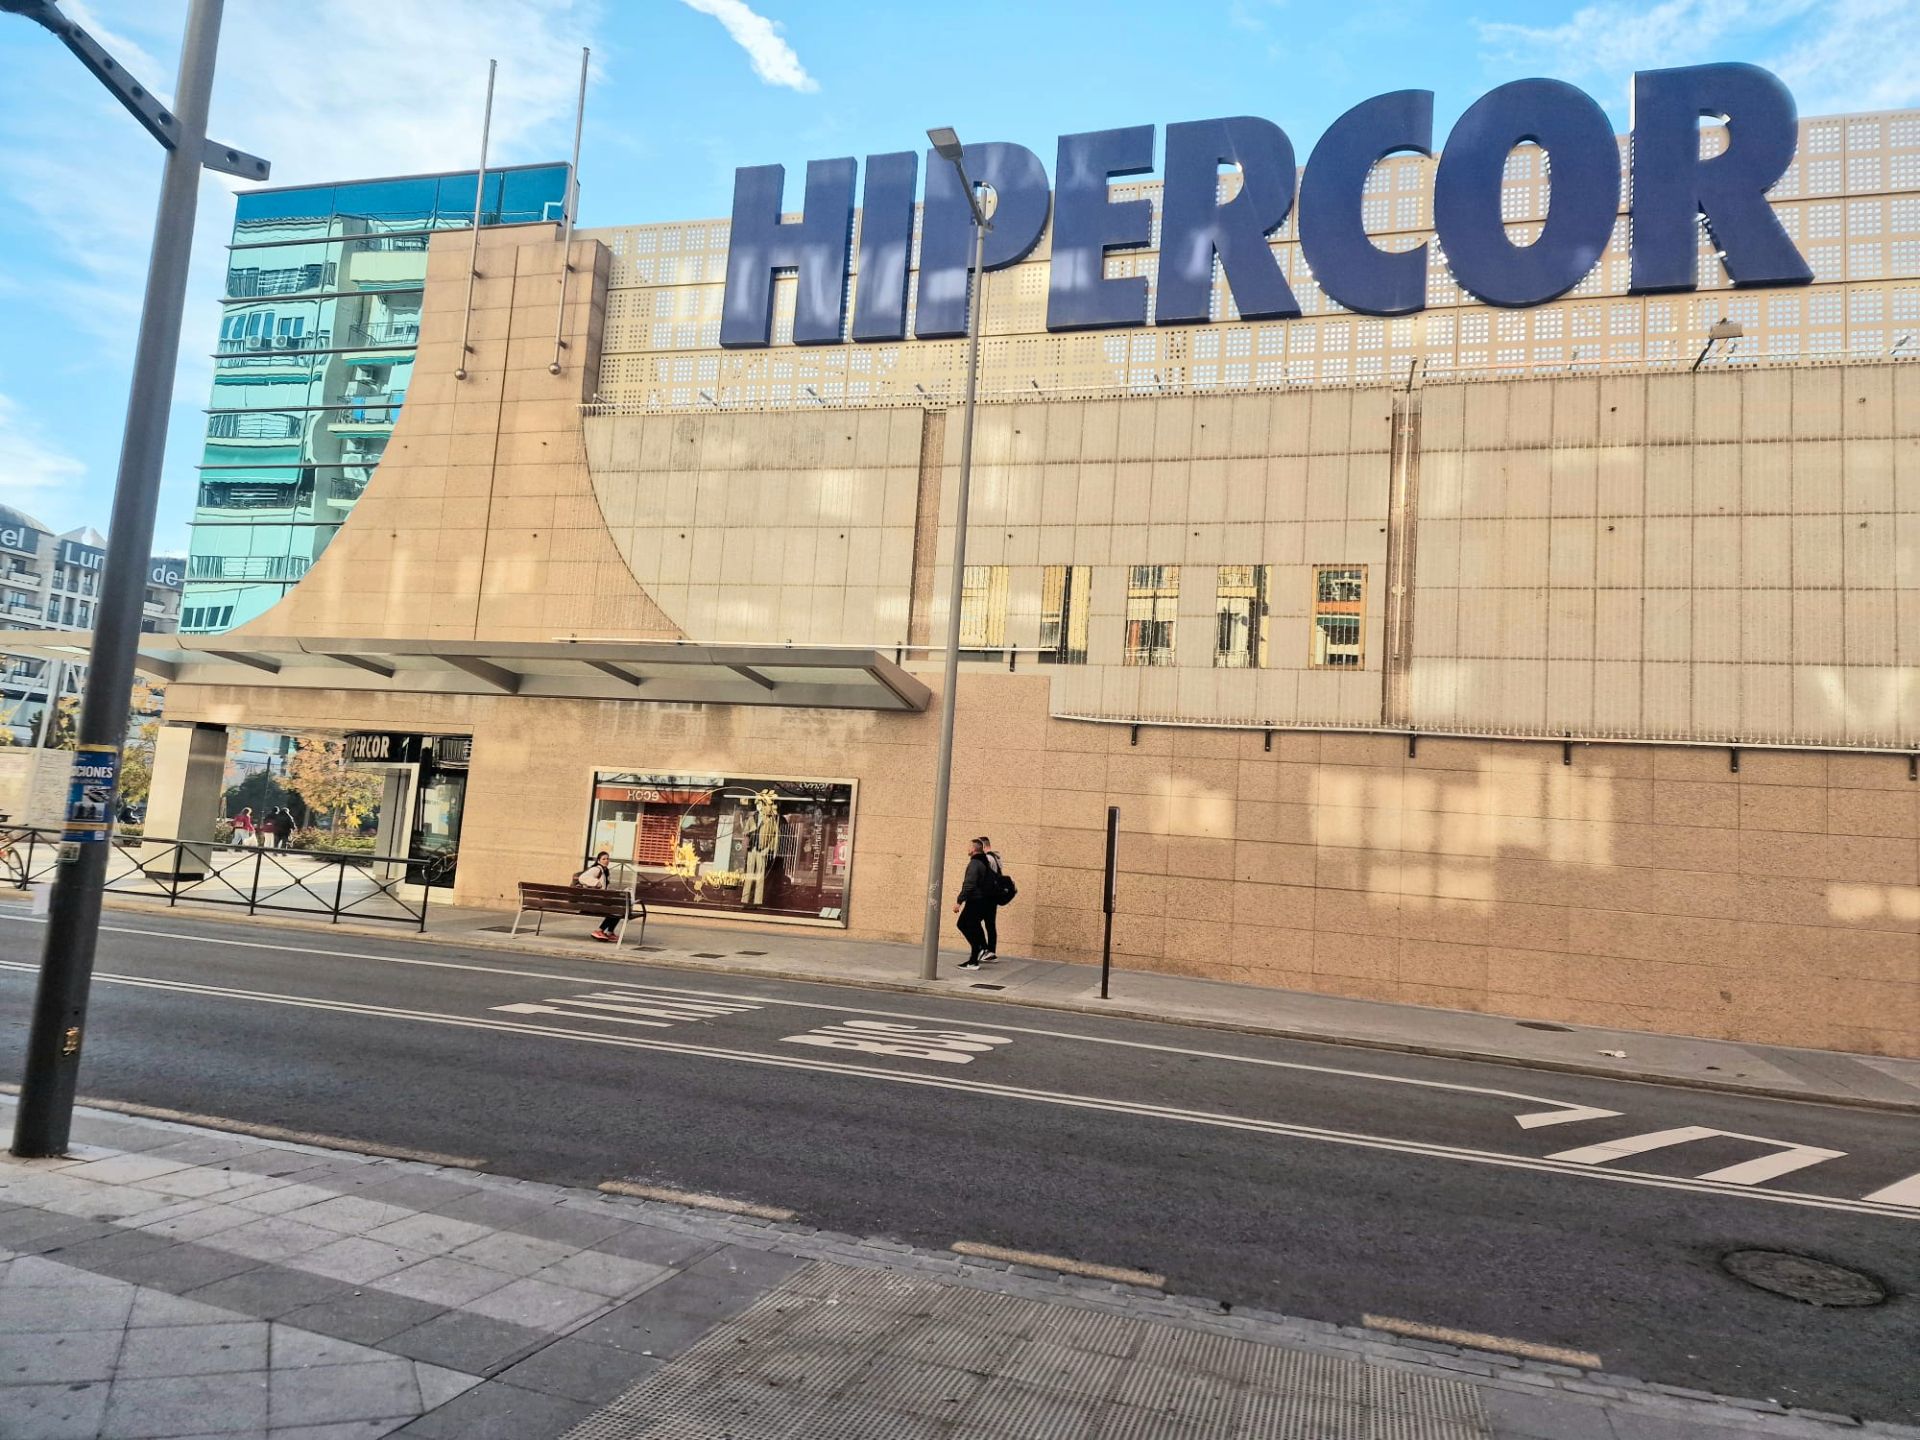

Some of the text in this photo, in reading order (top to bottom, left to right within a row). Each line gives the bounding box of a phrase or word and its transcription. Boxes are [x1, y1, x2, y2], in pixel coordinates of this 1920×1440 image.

[720, 61, 1814, 349] HIPERCOR
[0, 527, 26, 549] el
[152, 564, 179, 586] de
